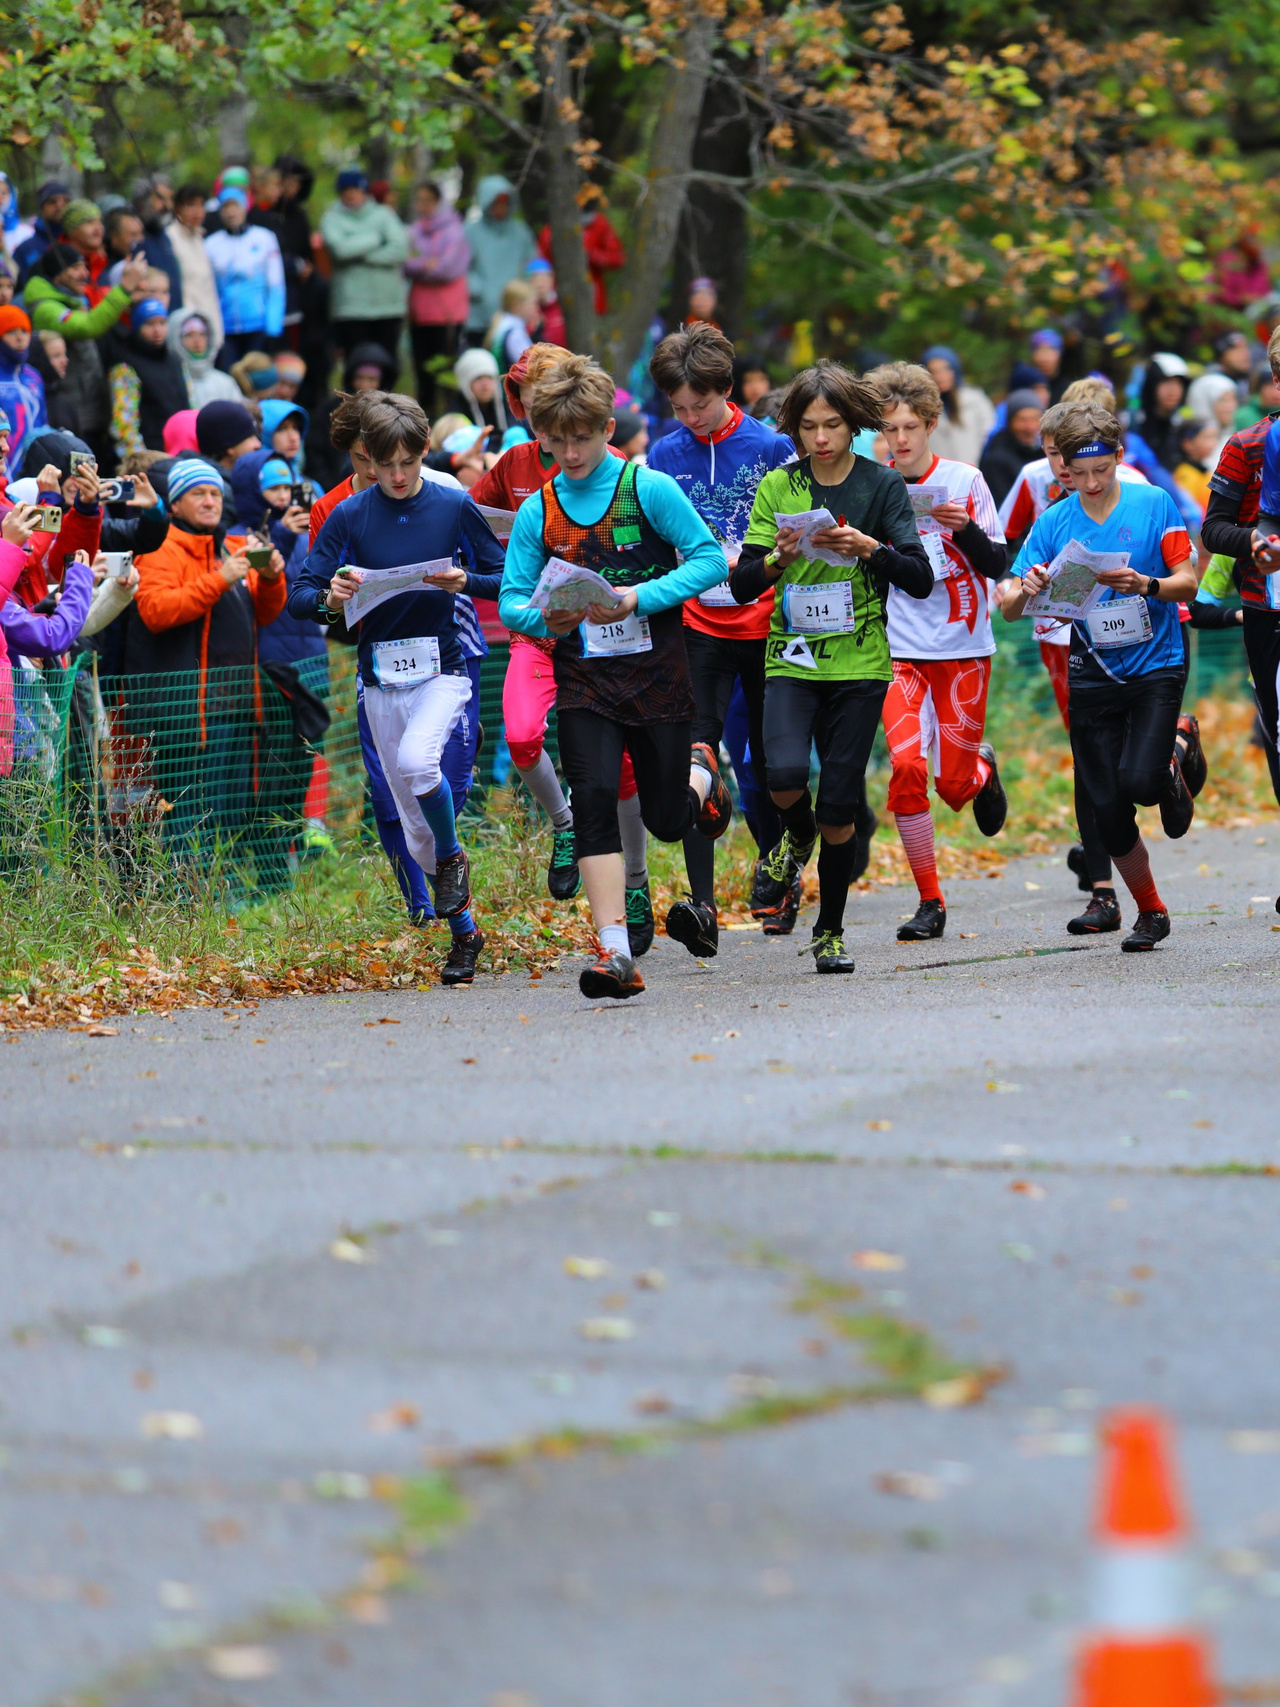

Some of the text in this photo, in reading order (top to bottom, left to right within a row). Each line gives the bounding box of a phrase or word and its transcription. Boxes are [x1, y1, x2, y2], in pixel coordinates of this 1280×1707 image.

[956, 580, 973, 617] think
[805, 604, 829, 617] 214
[601, 623, 624, 638] 218
[1102, 618, 1125, 631] 209
[393, 657, 416, 672] 224
